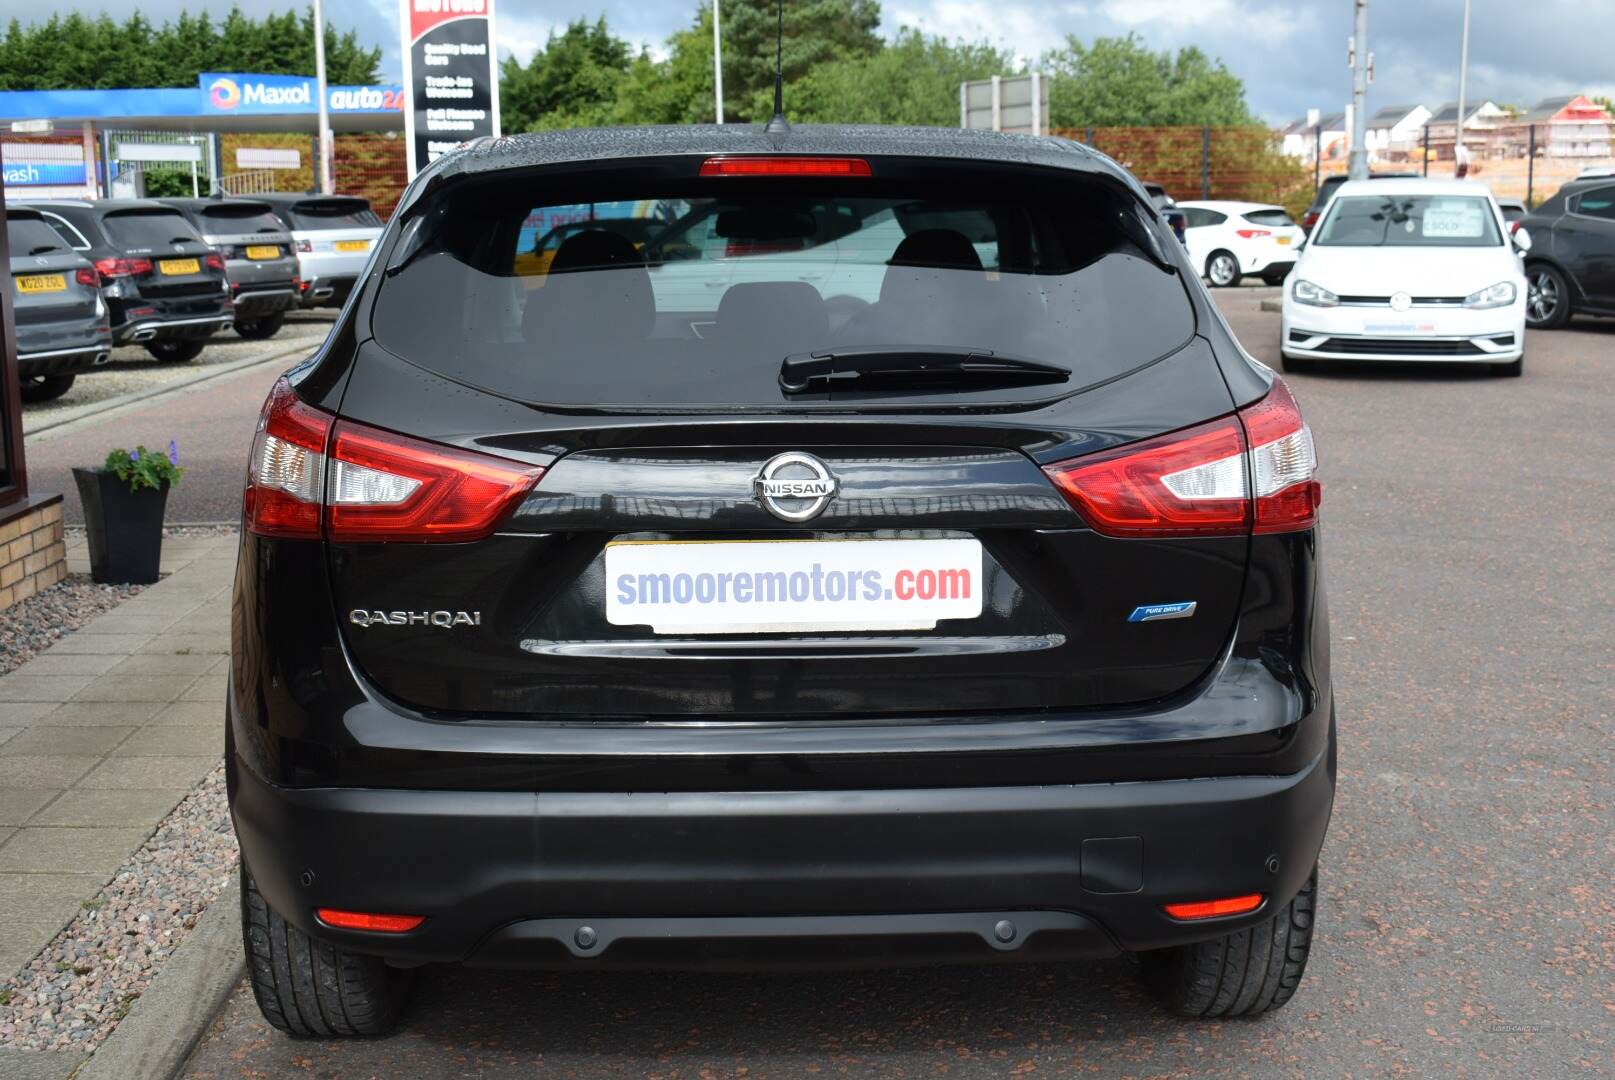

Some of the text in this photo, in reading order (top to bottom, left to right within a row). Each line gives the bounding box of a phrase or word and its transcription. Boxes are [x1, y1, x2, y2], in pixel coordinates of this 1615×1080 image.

[244, 82, 310, 104] Maxol
[764, 483, 827, 494] NISSAN
[617, 562, 971, 605] smooremotors.com
[349, 609, 480, 628] QASHQAI
